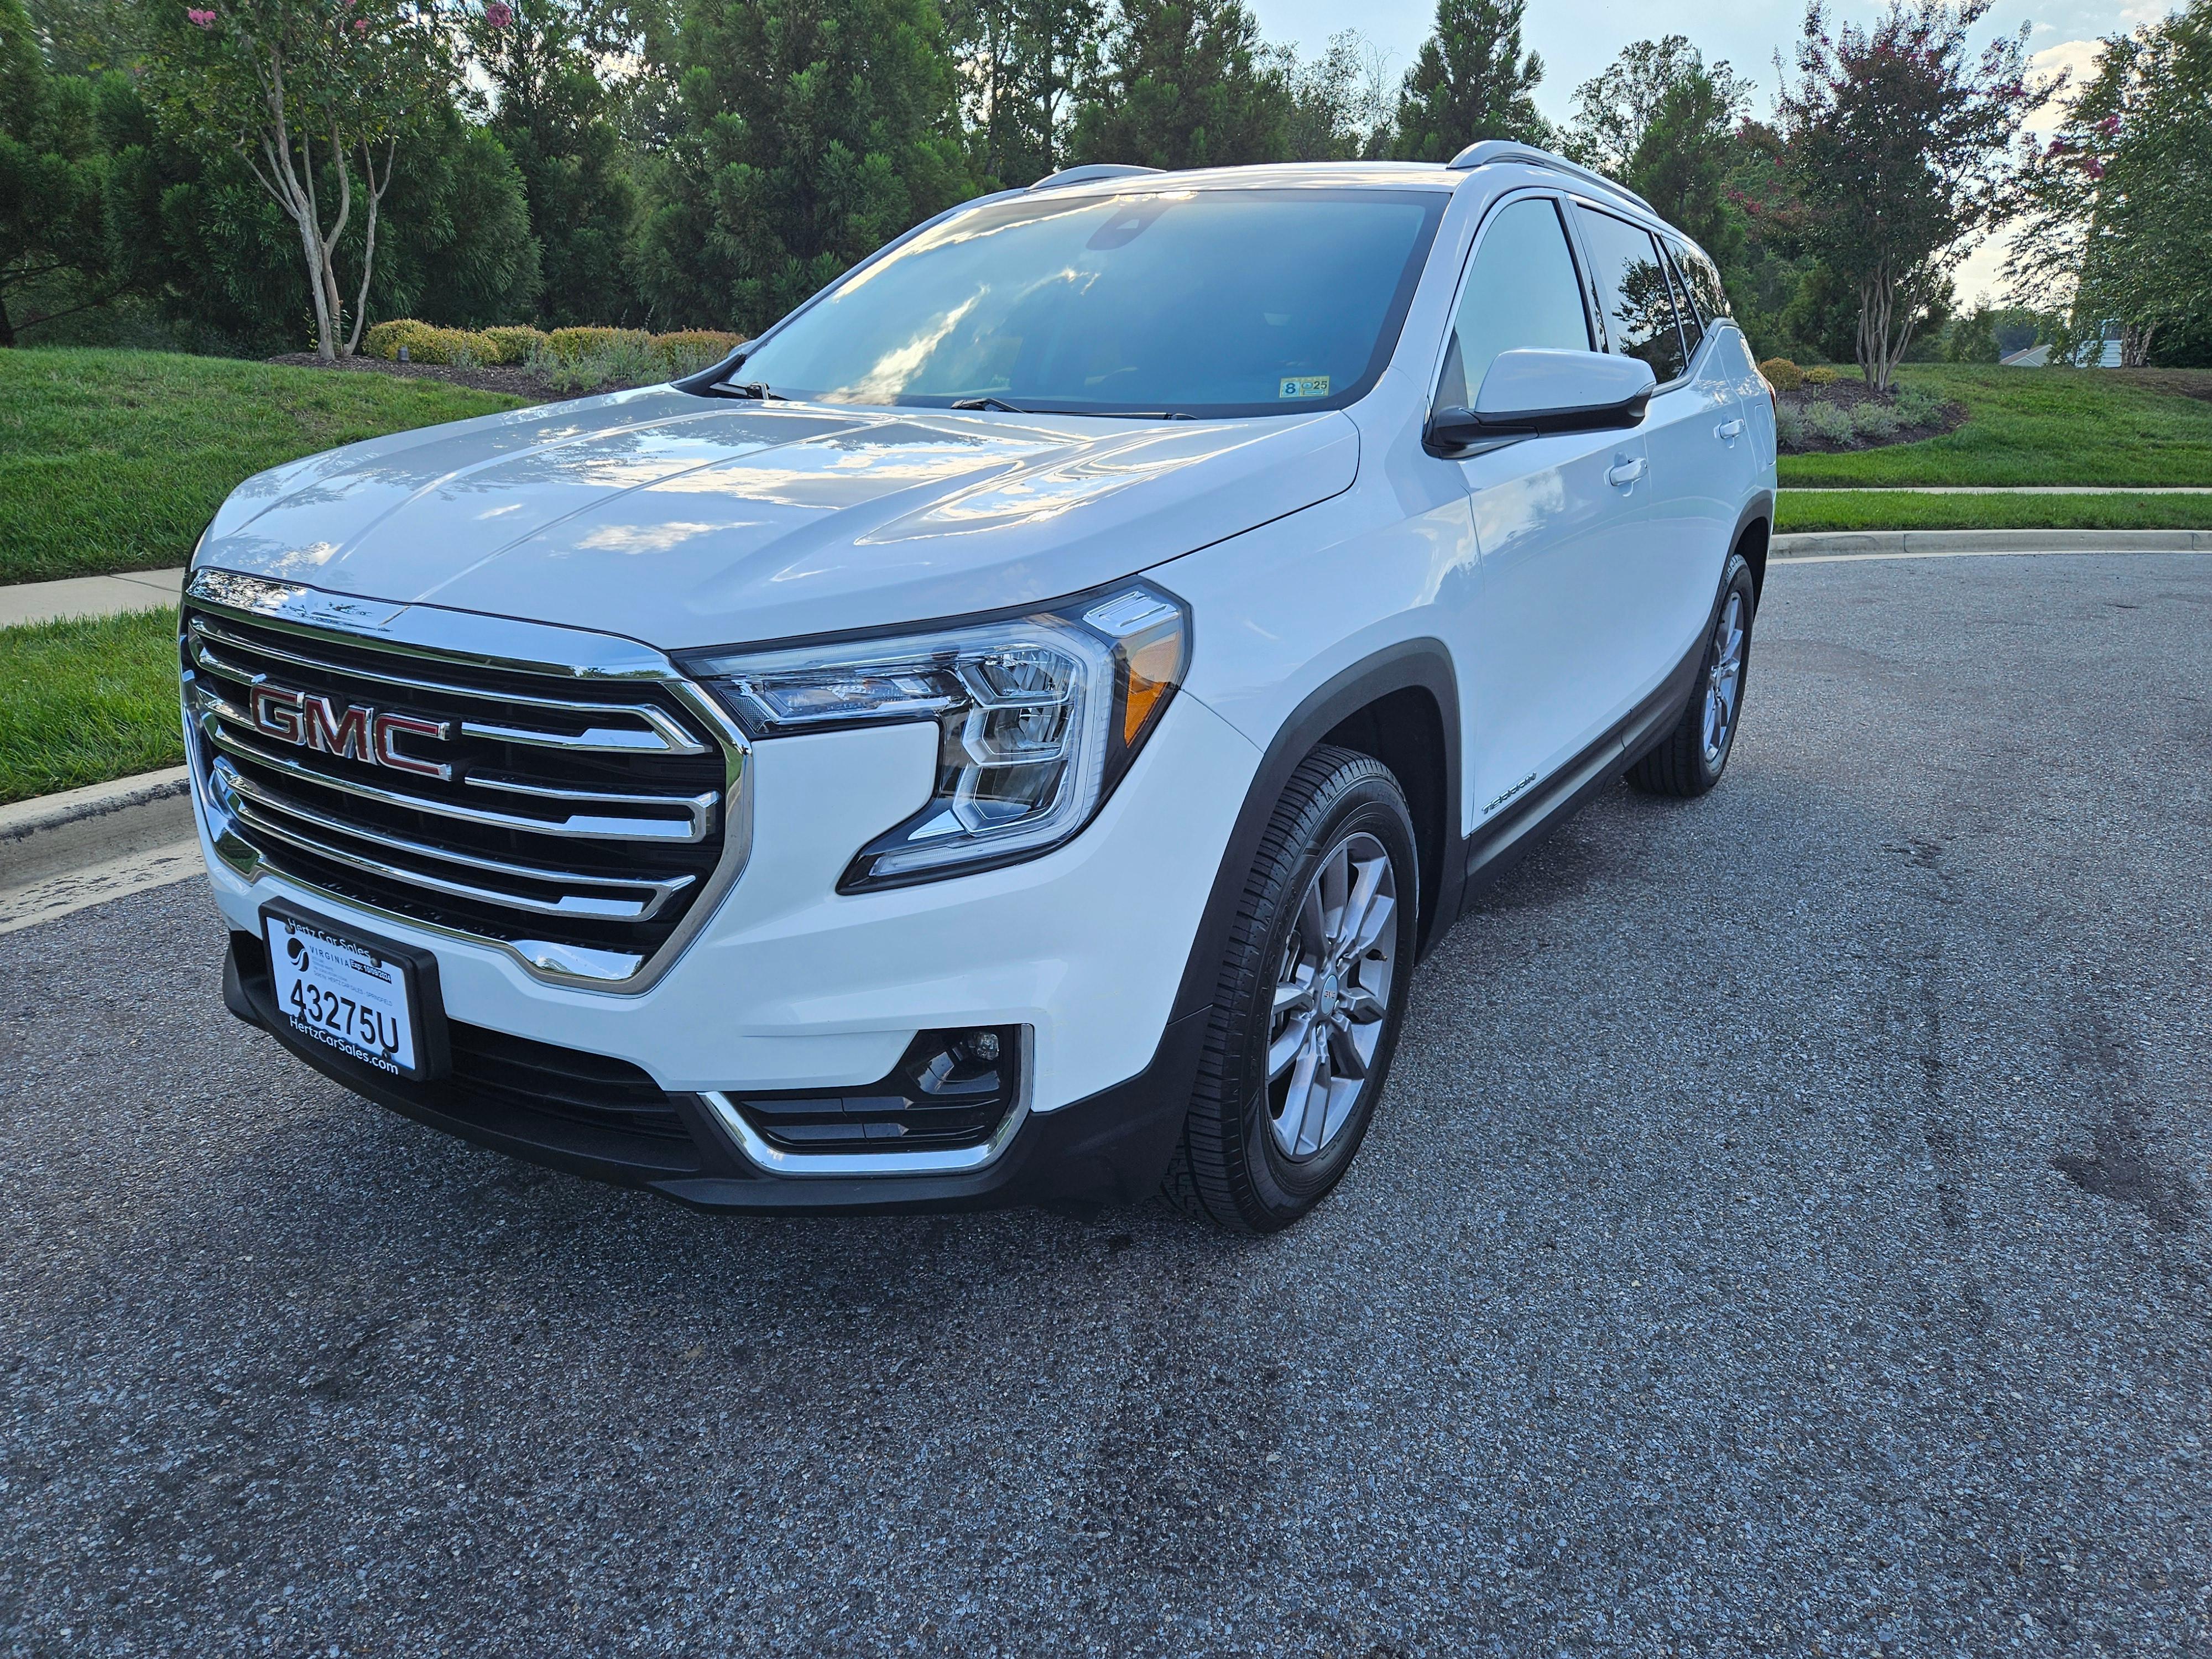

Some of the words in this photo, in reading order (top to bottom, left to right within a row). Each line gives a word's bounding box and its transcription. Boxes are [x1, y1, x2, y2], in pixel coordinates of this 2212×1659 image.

[1285, 383, 1296, 394] 8
[1313, 380, 1327, 389] 25
[250, 683, 452, 781] GMC
[288, 918, 315, 937] Hertz
[310, 946, 349, 968] VIRGINIA
[290, 979, 399, 1054] 43275U
[290, 1016, 399, 1074] HertzCarSales.com
